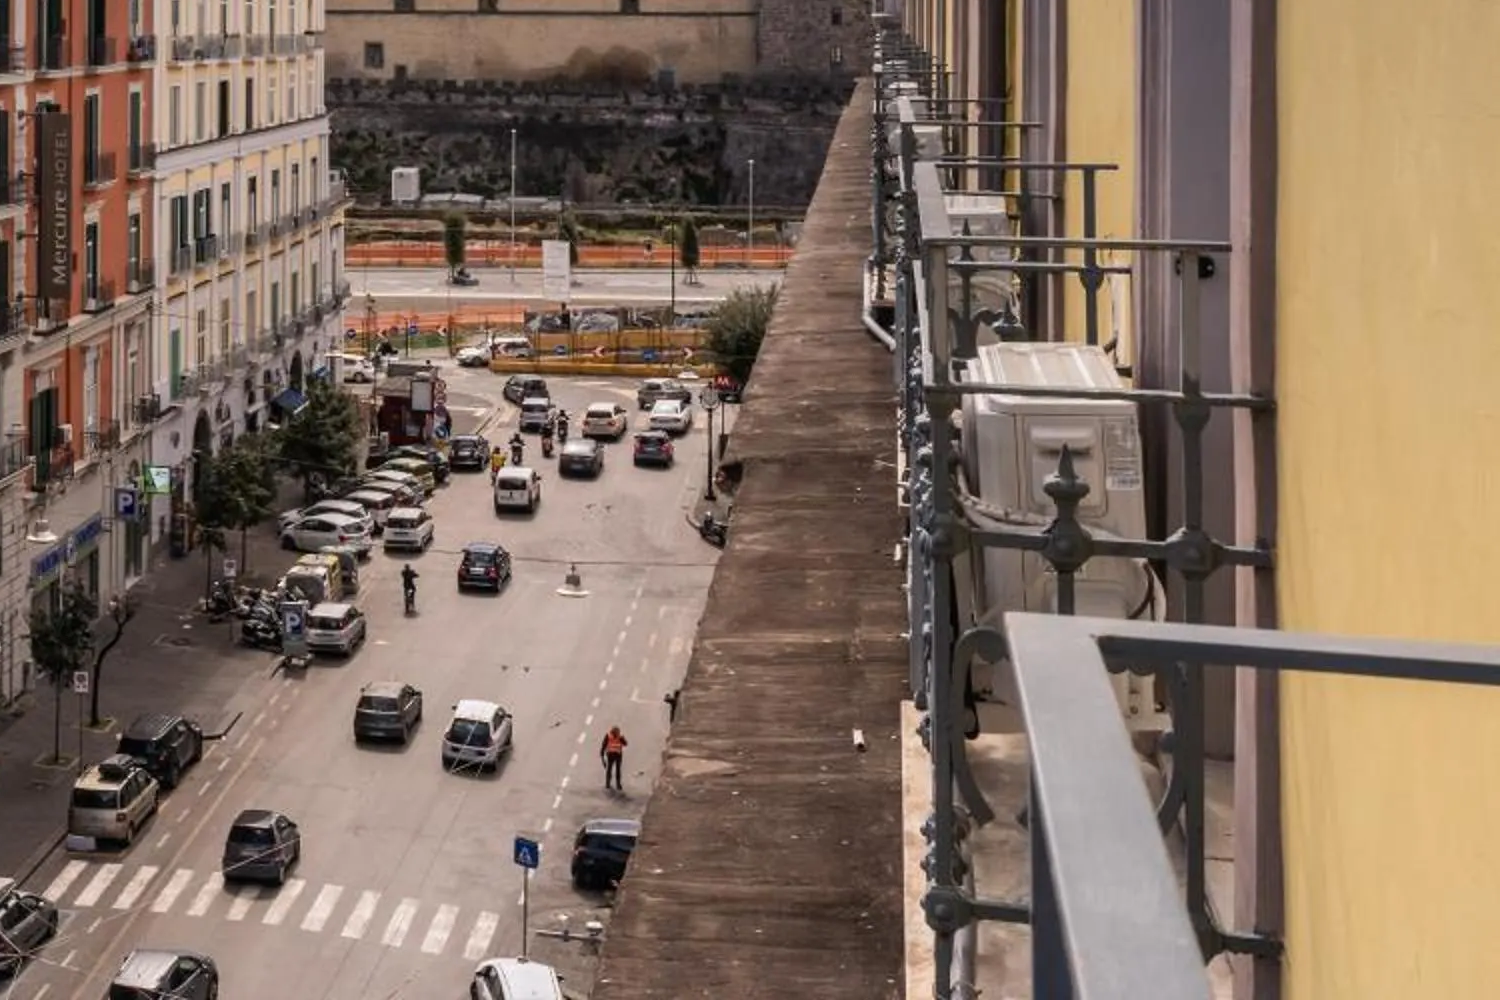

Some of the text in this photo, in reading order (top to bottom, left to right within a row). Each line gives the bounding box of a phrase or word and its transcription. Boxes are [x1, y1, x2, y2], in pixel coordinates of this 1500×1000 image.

[52, 131, 68, 285] Mercure HOTEL
[118, 492, 133, 513] P
[285, 612, 301, 633] P
